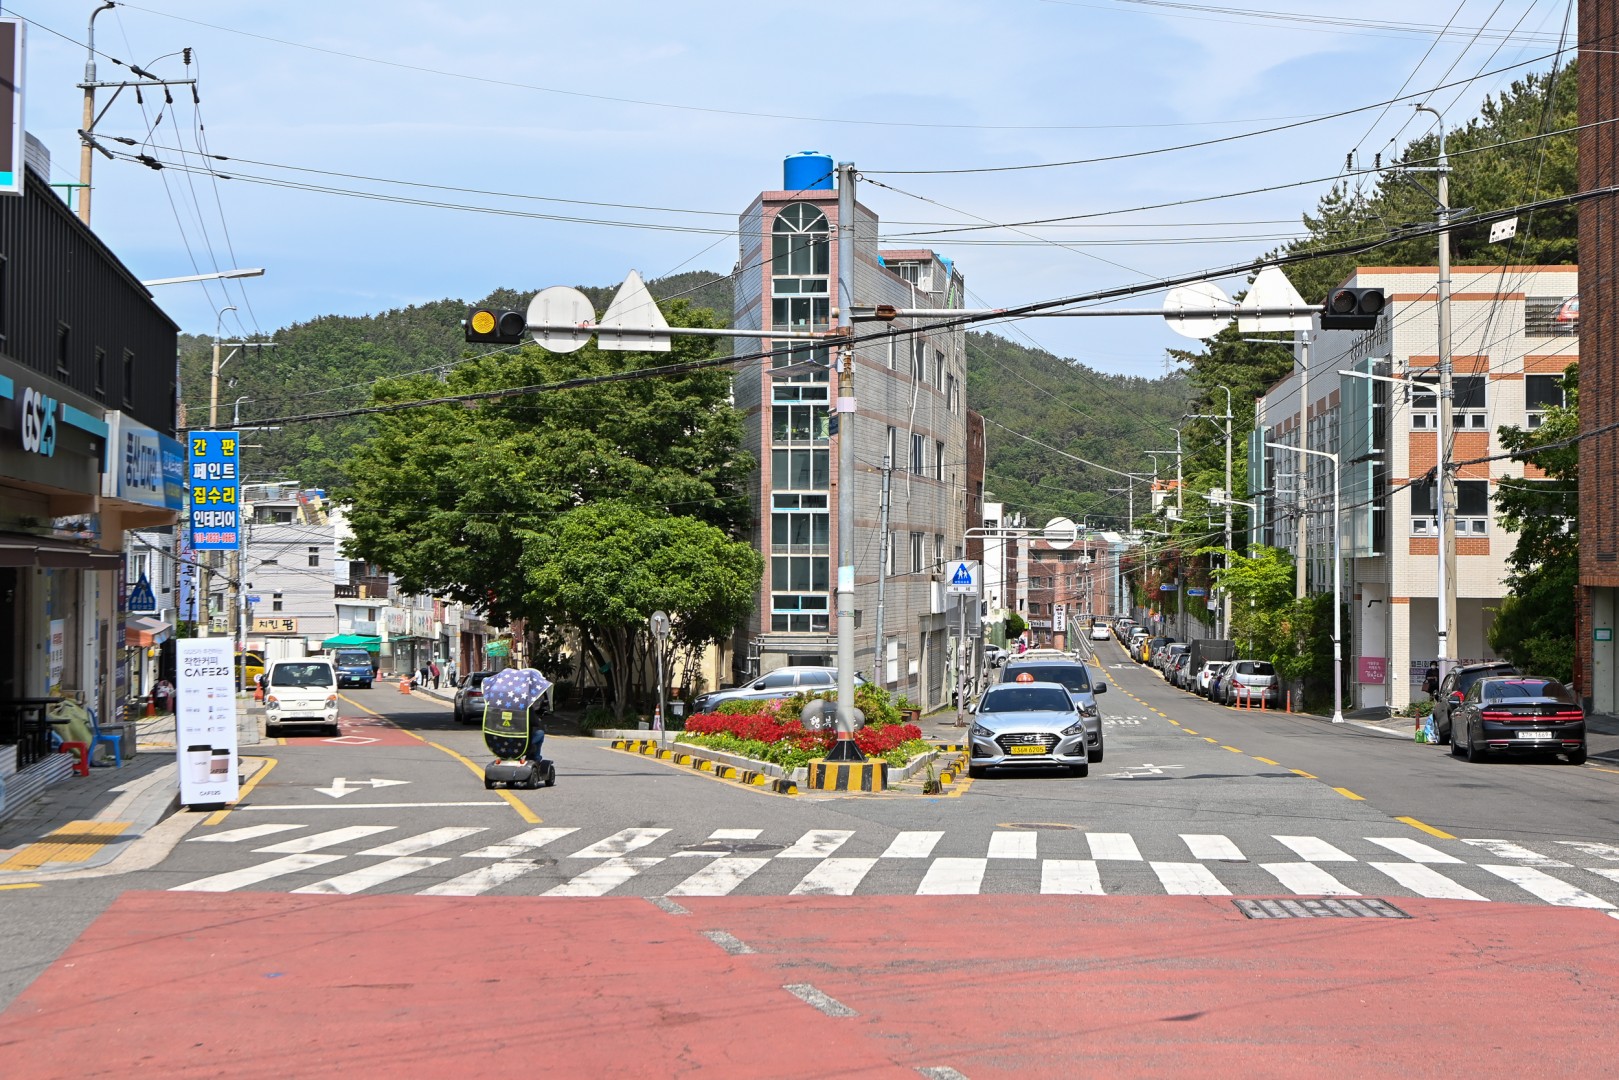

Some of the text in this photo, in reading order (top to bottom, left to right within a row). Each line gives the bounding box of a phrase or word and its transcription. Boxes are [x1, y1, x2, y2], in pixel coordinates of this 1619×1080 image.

[22, 387, 57, 458] GS25
[193, 463, 236, 480] 페인트
[193, 487, 236, 504] 집수리
[193, 510, 236, 528] 인테리어
[259, 619, 293, 631] 치킨 팜
[184, 656, 218, 667] 착한커피
[184, 667, 229, 677] CAFE25
